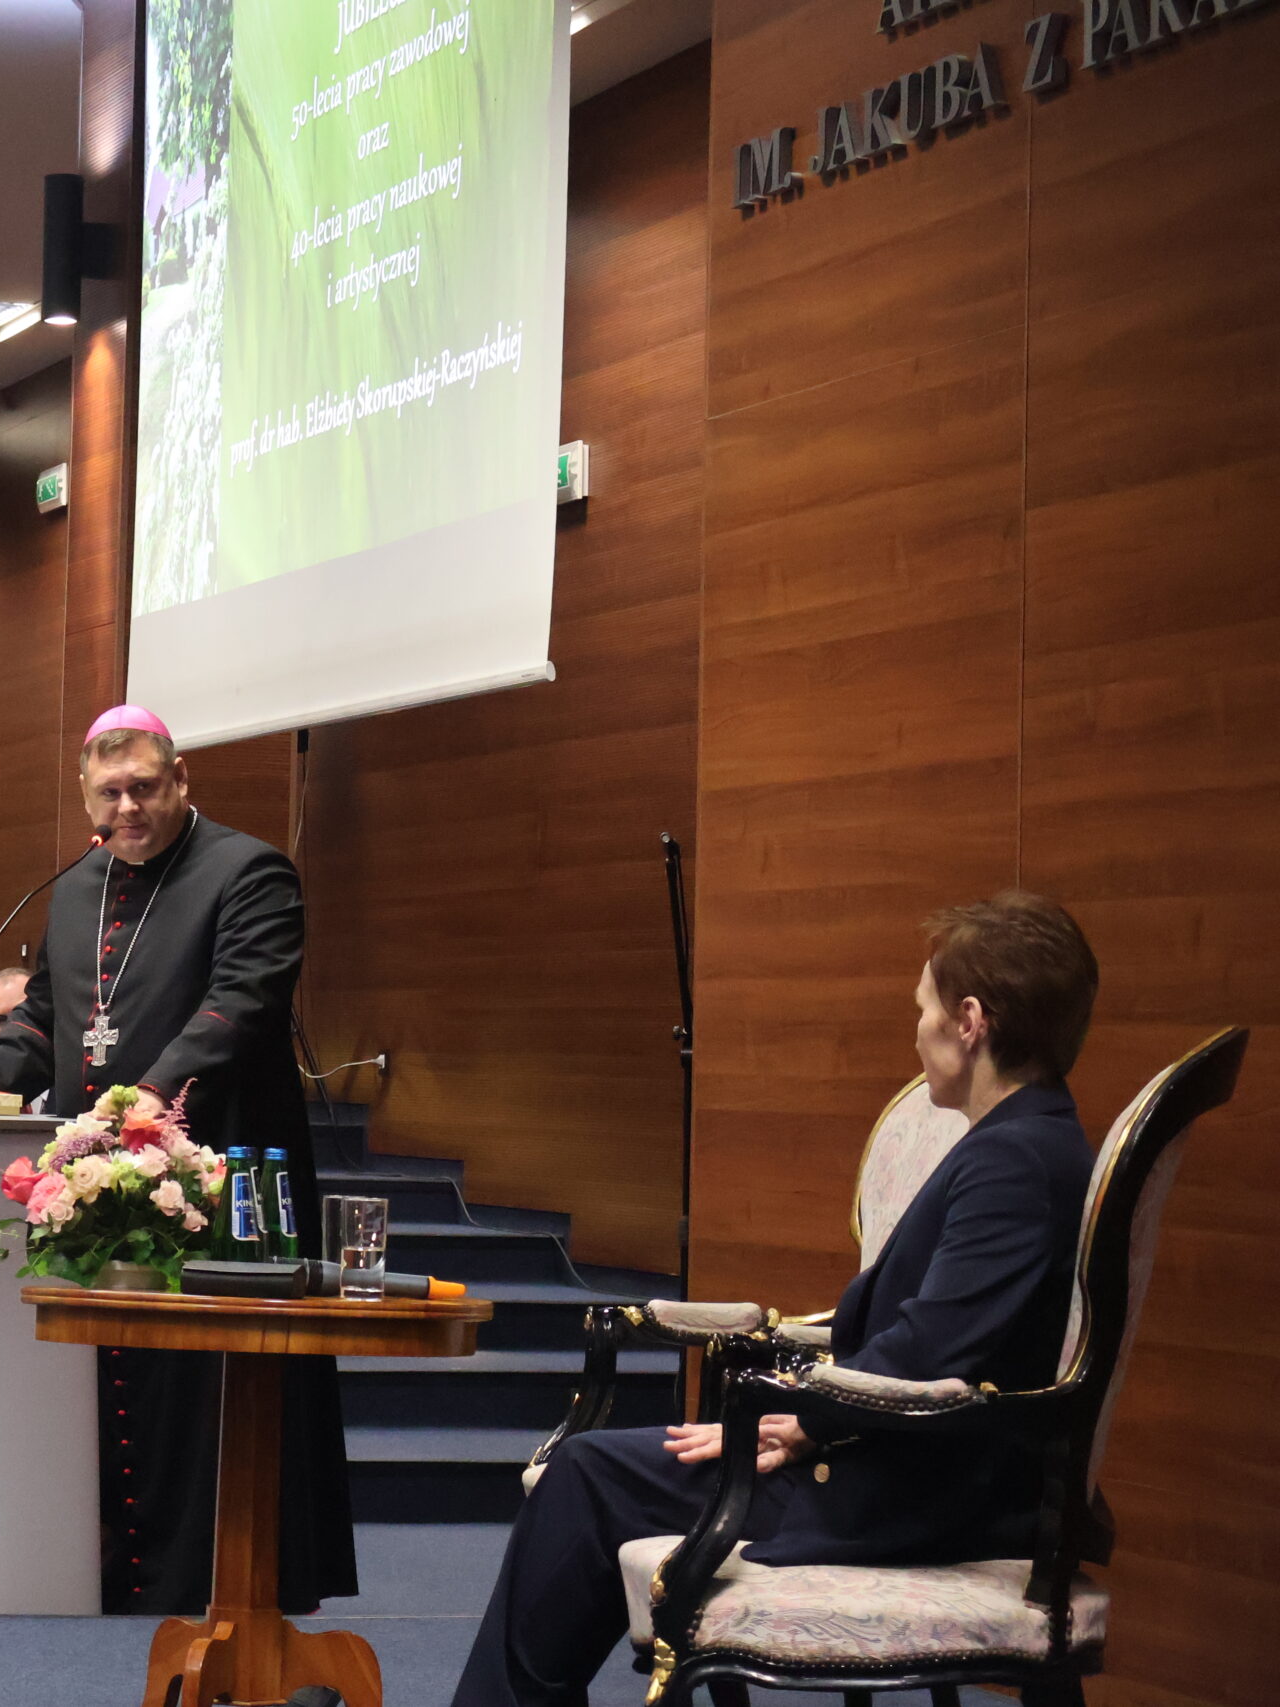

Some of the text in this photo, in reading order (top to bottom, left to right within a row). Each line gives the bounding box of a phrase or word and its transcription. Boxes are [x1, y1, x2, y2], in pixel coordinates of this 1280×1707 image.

[290, 0, 470, 142] 50-lecia pracy zawodowej
[333, 0, 406, 54] JUBIL
[808, 42, 1010, 176] JAKUBA
[1022, 12, 1068, 93] Z
[1078, 0, 1256, 71] PAR
[358, 121, 390, 160] oraz
[290, 143, 462, 268] 40-lecia pracy naukowej
[327, 232, 421, 312] i artystycznej
[229, 320, 523, 479] prof. dr hab. Elżbiety Skorupskiej-Raczyńskiej
